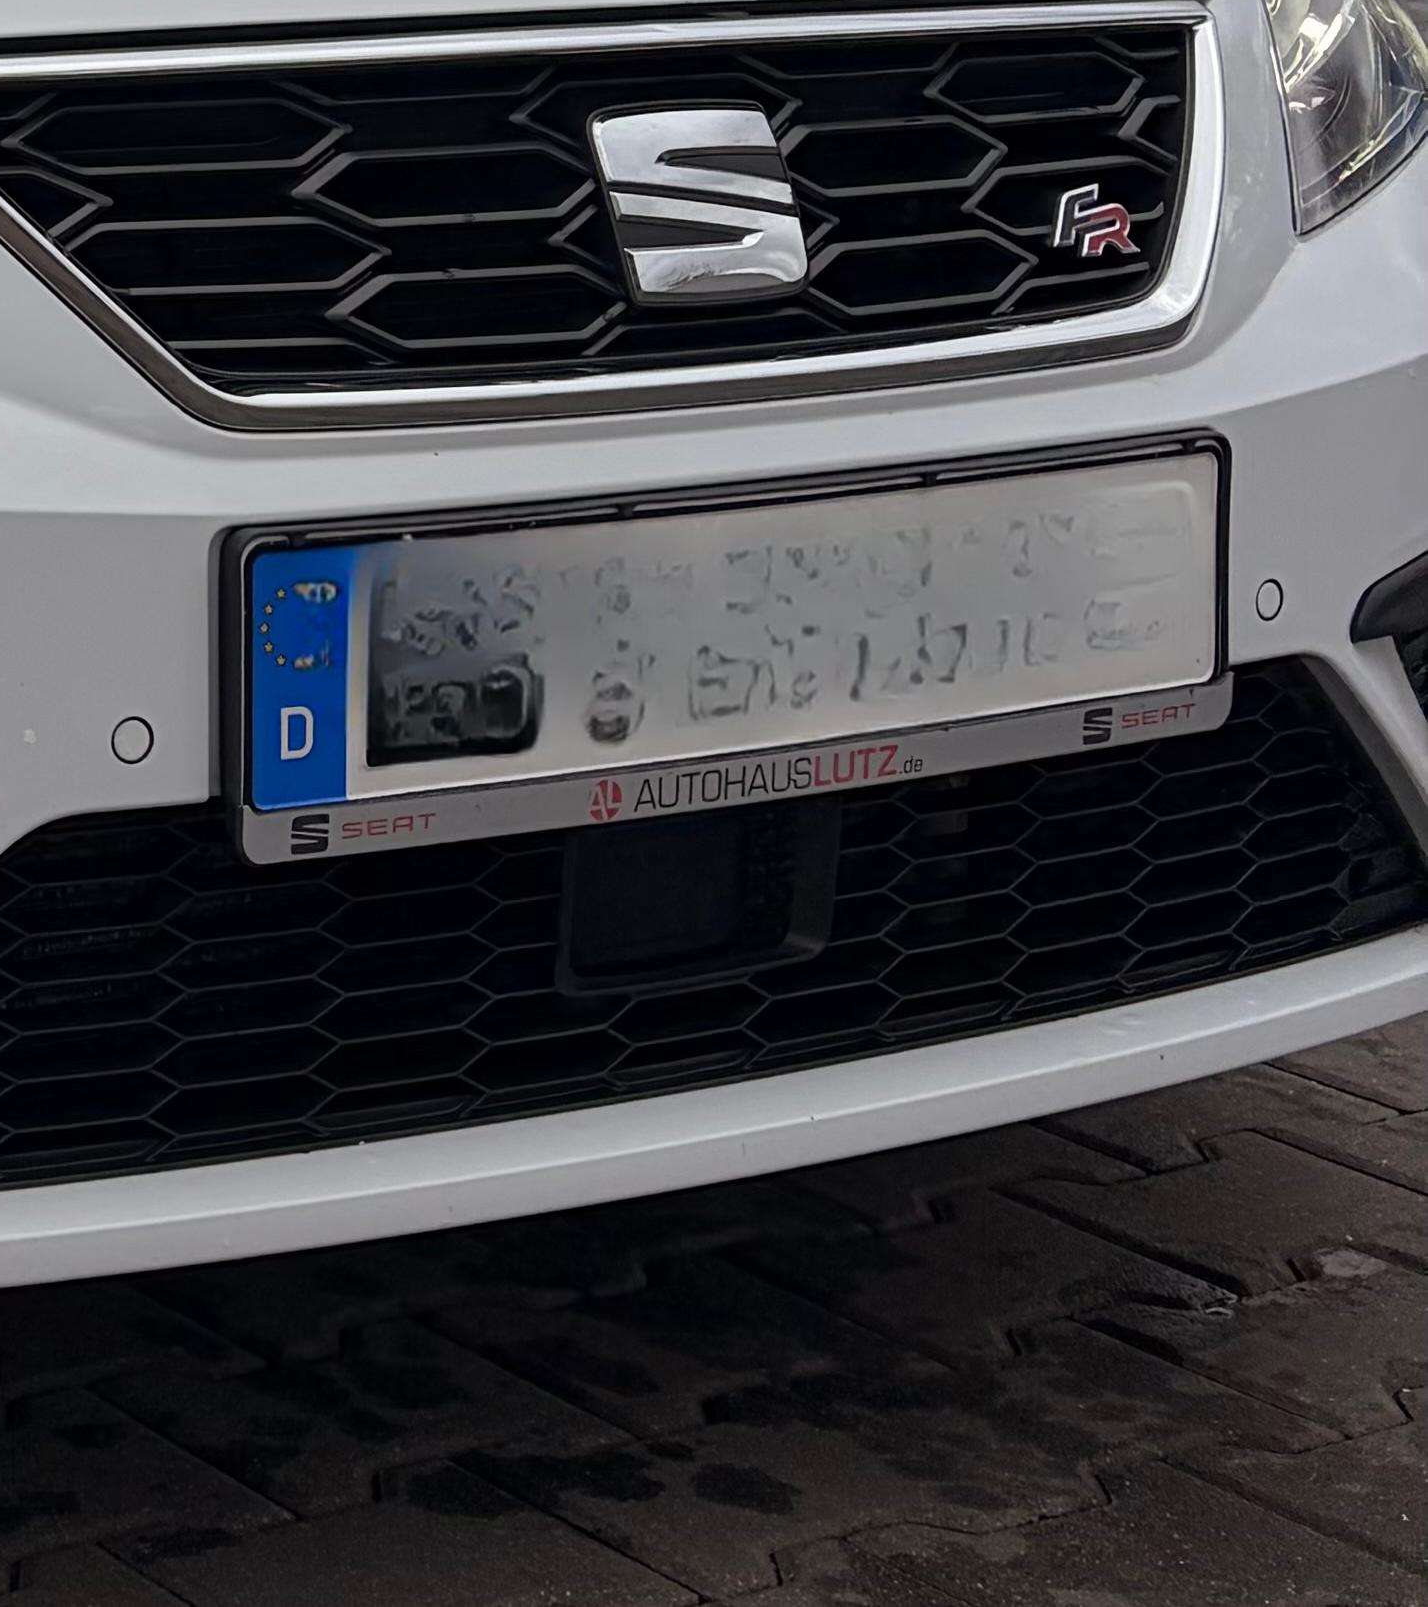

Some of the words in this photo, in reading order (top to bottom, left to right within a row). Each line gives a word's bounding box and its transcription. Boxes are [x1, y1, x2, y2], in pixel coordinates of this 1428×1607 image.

[1051, 183, 1141, 258] FR
[280, 705, 314, 760] D
[1120, 702, 1197, 729] SEAT
[341, 811, 437, 840] SEAT
